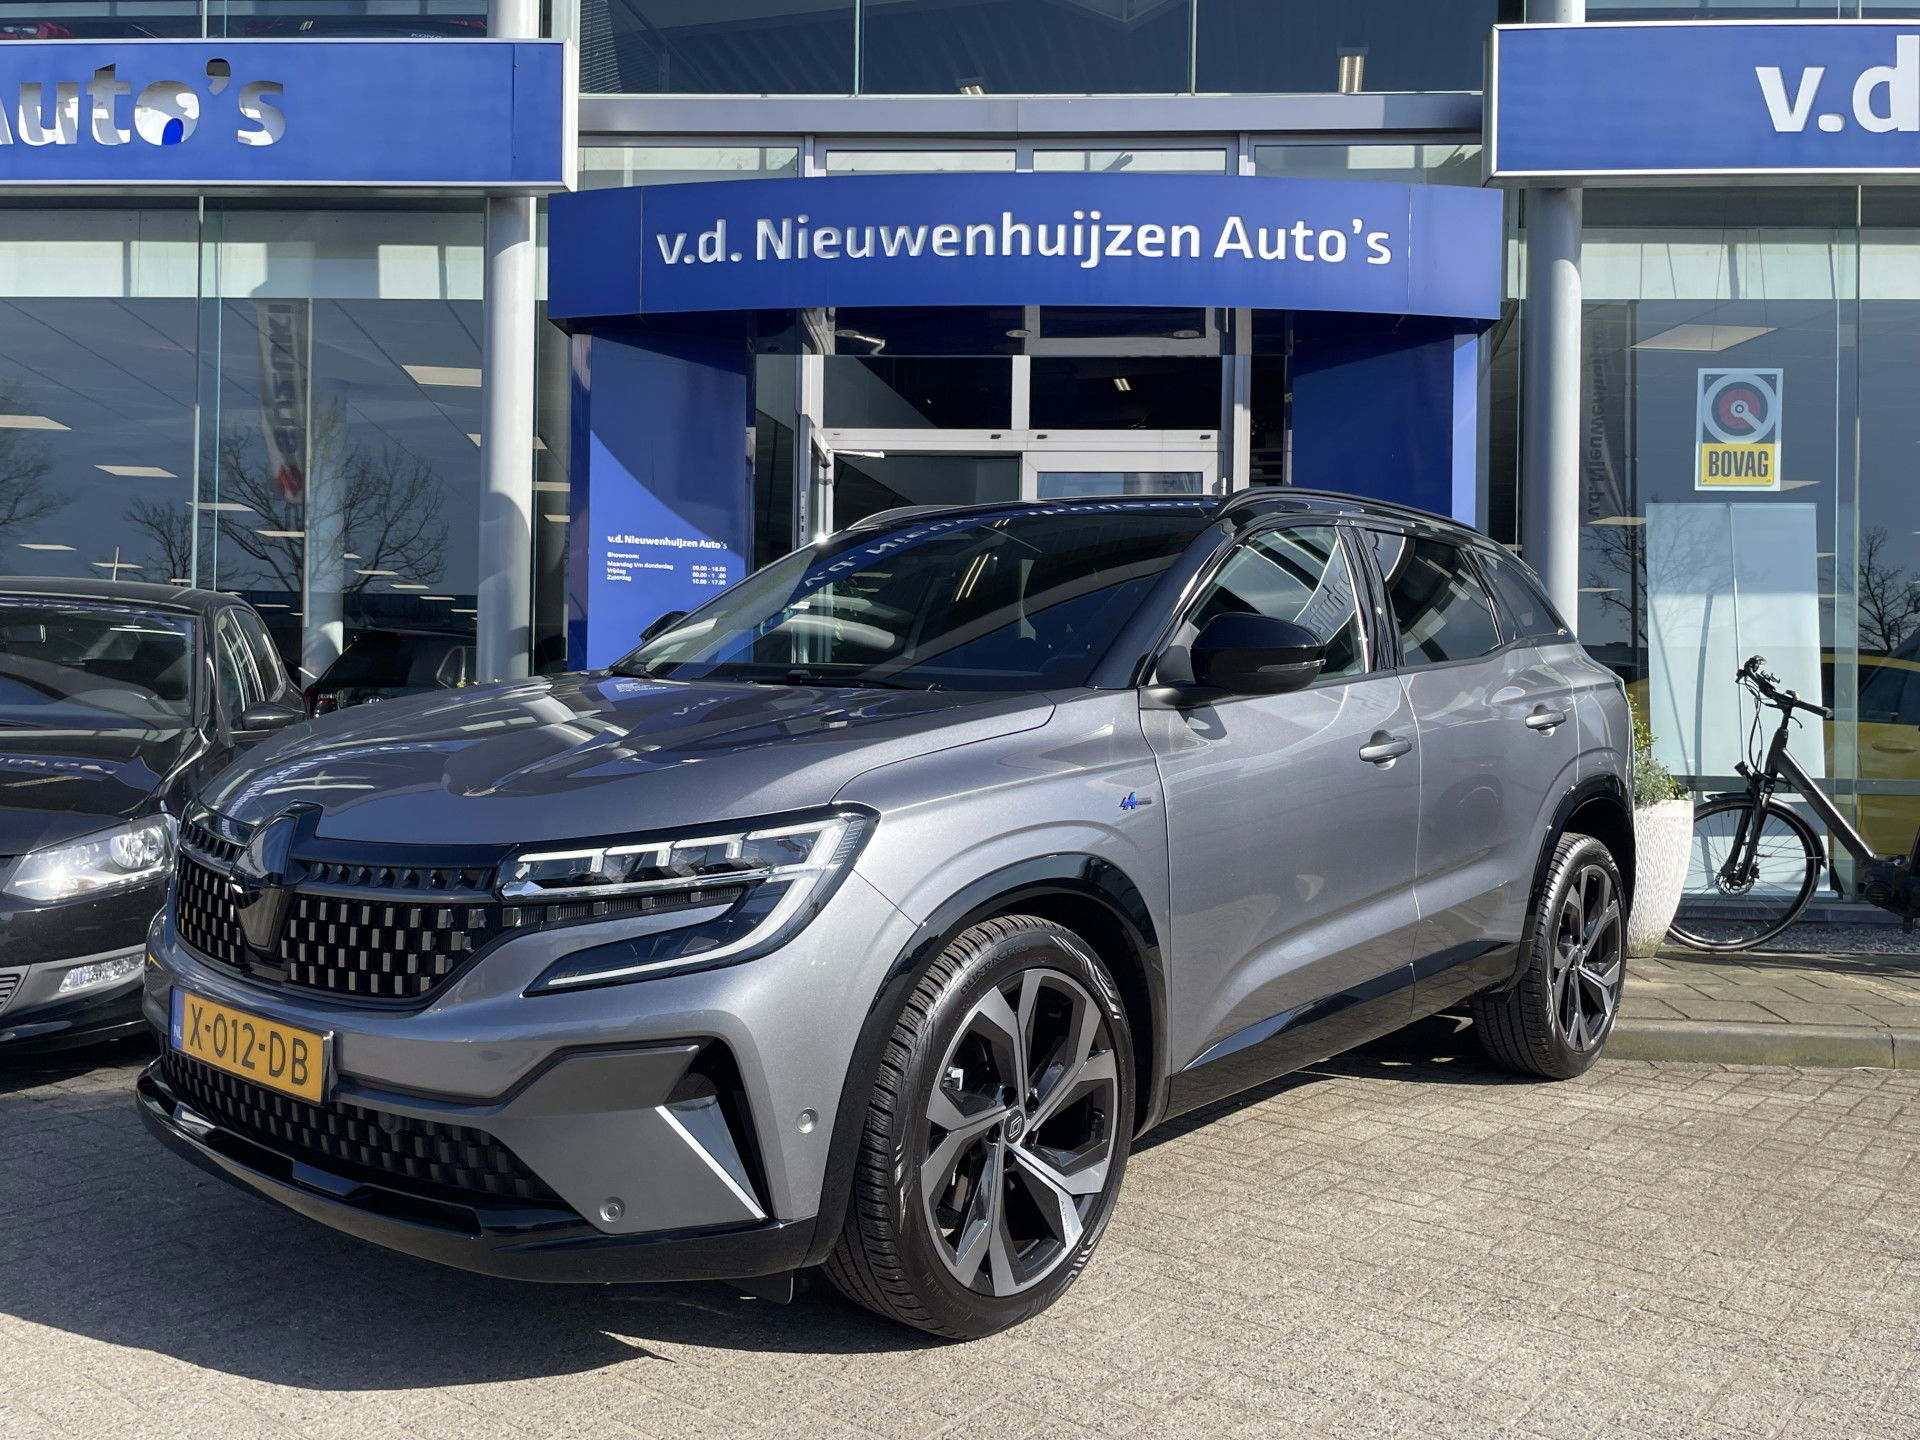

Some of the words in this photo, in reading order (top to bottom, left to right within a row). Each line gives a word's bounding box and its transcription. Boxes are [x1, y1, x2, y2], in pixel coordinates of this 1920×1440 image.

[0, 57, 287, 146] uto's
[656, 219, 743, 265] v.d.
[756, 211, 1200, 269] Nieuwenhuijzen
[1214, 216, 1393, 265] Auto's
[1708, 450, 1769, 477] BOVAG
[607, 533, 623, 543] v.d.
[624, 535, 698, 549] Nieuwenhuijzen
[699, 540, 727, 550] Auto's
[173, 1024, 182, 1040] NL
[190, 1003, 308, 1086] X-012-DB
